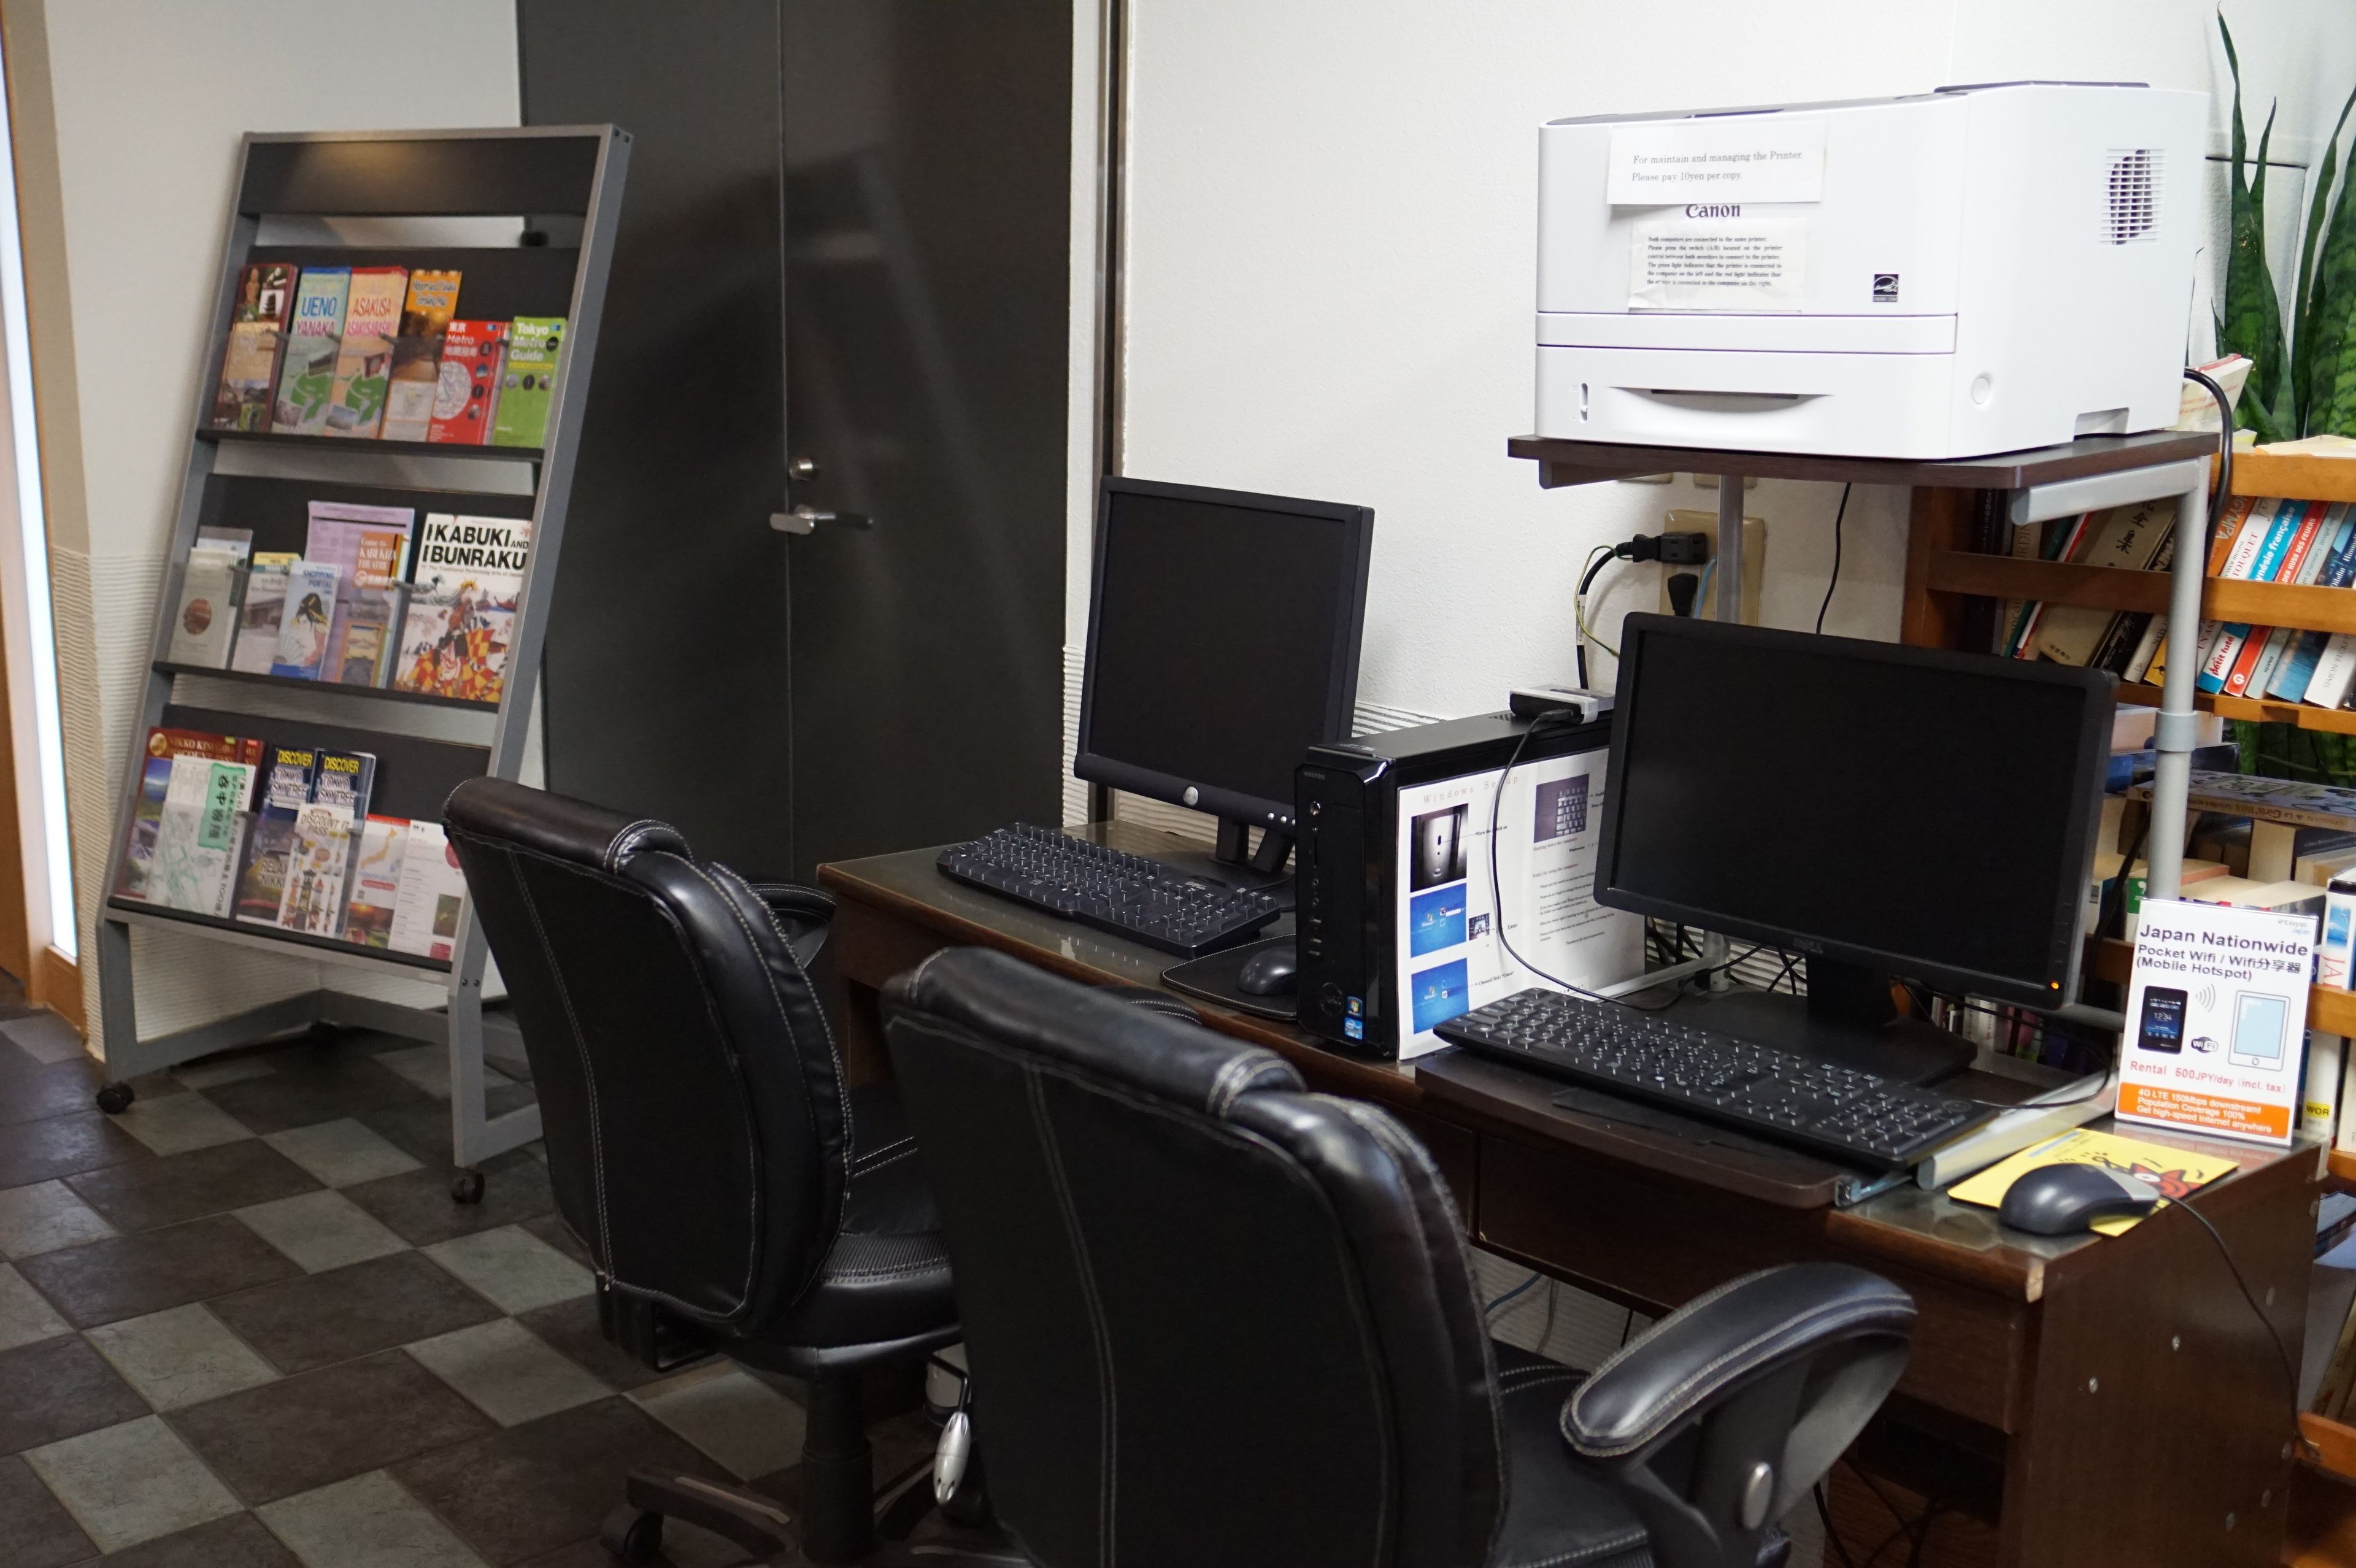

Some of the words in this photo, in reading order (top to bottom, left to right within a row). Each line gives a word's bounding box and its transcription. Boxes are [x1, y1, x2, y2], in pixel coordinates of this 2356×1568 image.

[1633, 155, 1648, 164] For
[1650, 154, 1688, 164] maintain
[1692, 153, 1706, 163] and
[1709, 152, 1750, 163] managing
[1753, 152, 1767, 160] the
[1770, 151, 1803, 159] Printer.
[1632, 173, 1660, 182] Please
[1680, 172, 1704, 182] 10yen
[1707, 173, 1720, 182] per
[1722, 172, 1742, 181] copy.
[1685, 204, 1741, 218] Canon
[301, 296, 337, 317] UENO
[353, 298, 392, 317] ASAKUSA
[296, 320, 335, 336] YANAKA
[517, 322, 550, 336] Tokyo
[446, 334, 475, 344] Metro
[512, 336, 546, 347] Metro
[510, 349, 544, 361] Guide
[510, 540, 529, 549] AND
[2255, 551, 2274, 581] ynésie
[2268, 507, 2295, 550] française
[2282, 570, 2292, 583] DER
[2290, 554, 2300, 571] KUSS
[2301, 518, 2316, 541] FEUERS
[2233, 532, 2258, 577] TOUQUET
[2209, 654, 2222, 675] petit
[2323, 664, 2339, 688] SIMON
[277, 750, 312, 767] DISCOVER
[324, 756, 360, 774] DISCOVER
[323, 775, 350, 791] TOKYO
[1303, 771, 1325, 780] VOSTRO
[1423, 786, 1474, 804] Windows
[1484, 776, 1519, 790] Seup
[301, 814, 340, 829] DISCOUNT
[2284, 920, 2308, 929] Easygo
[2292, 928, 2311, 937] Japan
[2140, 924, 2195, 943] Japan
[2203, 931, 2308, 957] Nationwide
[2138, 944, 2185, 959] Pocket
[2190, 950, 2216, 964] Wifi
[2136, 956, 2187, 972] (Mobile
[2192, 963, 2252, 982] Hotspot)
[2321, 954, 2346, 990] JA
[2130, 1061, 2167, 1075] Rental
[2175, 1067, 2235, 1087] 500JPY/day
[2138, 1088, 2151, 1097] 4G
[2152, 1091, 2169, 1101] LTE
[2171, 1093, 2208, 1106] 150Mbps
[2138, 1097, 2179, 1111] Population
[2181, 1104, 2220, 1118] Coverage
[2223, 1109, 2246, 1121] 100%
[2137, 1105, 2151, 1115] Get
[2153, 1107, 2198, 1122] high-speed
[2232, 1121, 2272, 1134] anywhere
